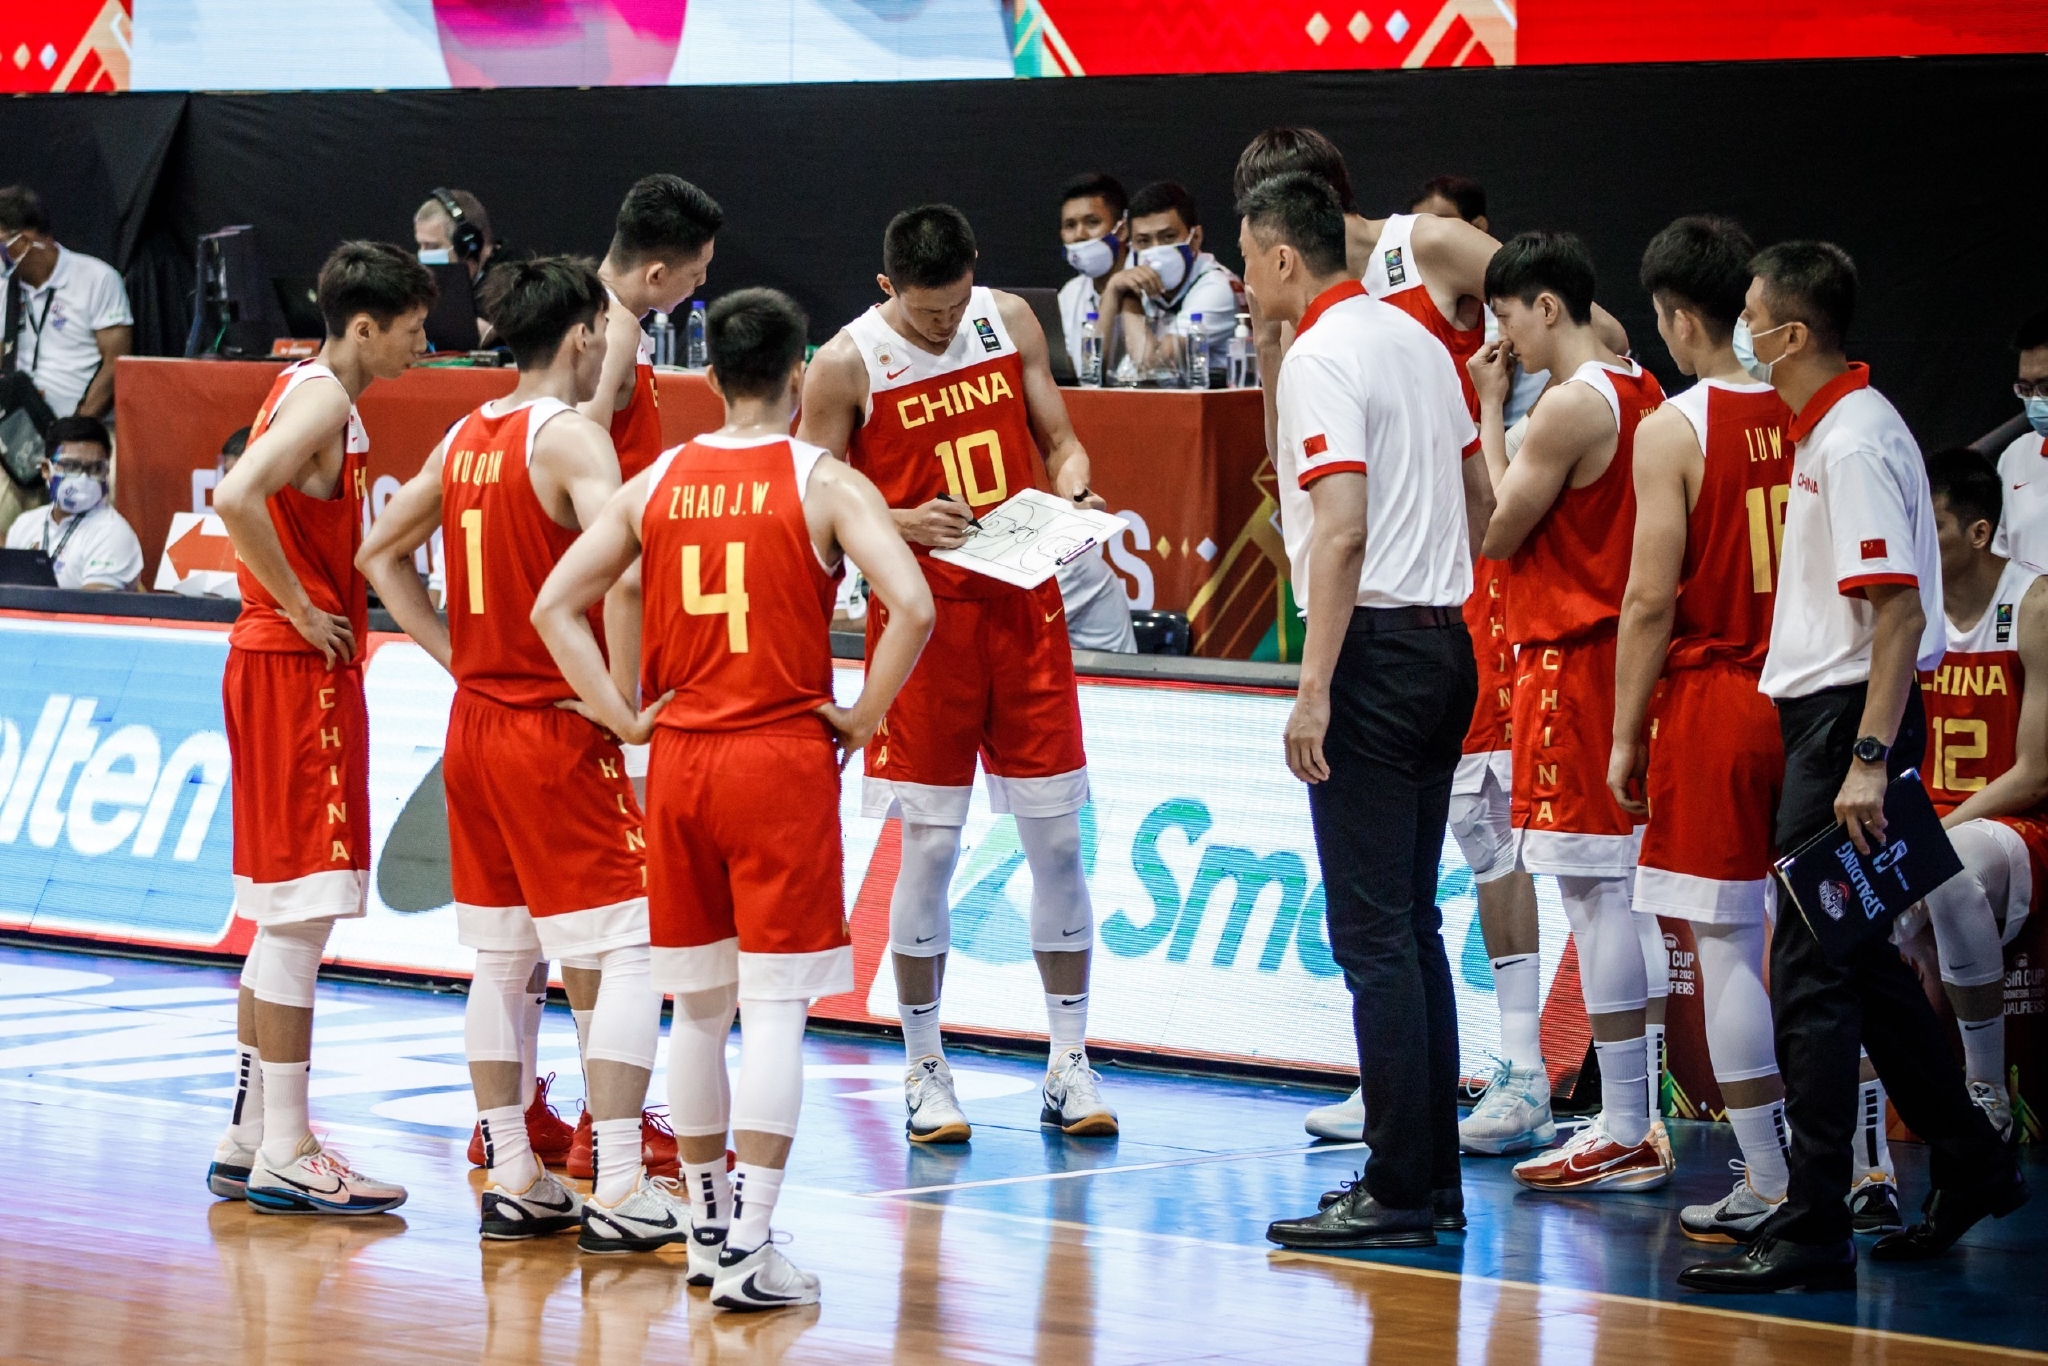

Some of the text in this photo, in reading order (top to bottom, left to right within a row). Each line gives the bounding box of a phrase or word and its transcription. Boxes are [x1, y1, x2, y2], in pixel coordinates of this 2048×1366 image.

[897, 371, 1014, 430] CHINA
[669, 481, 773, 519] ZHAO J.W.
[934, 429, 1008, 507] 10
[1797, 472, 1819, 495] CHINA
[461, 509, 485, 614] 1
[681, 541, 749, 653] 4
[318, 687, 351, 863] CHINA
[1536, 650, 1559, 823] CHINA
[1932, 716, 1988, 792] 12
[0, 693, 233, 863] lten
[1834, 840, 1886, 920] SPALDING
[1672, 951, 1695, 968] CUP
[1679, 970, 1695, 980] 2021
[2023, 969, 2045, 987] CUP
